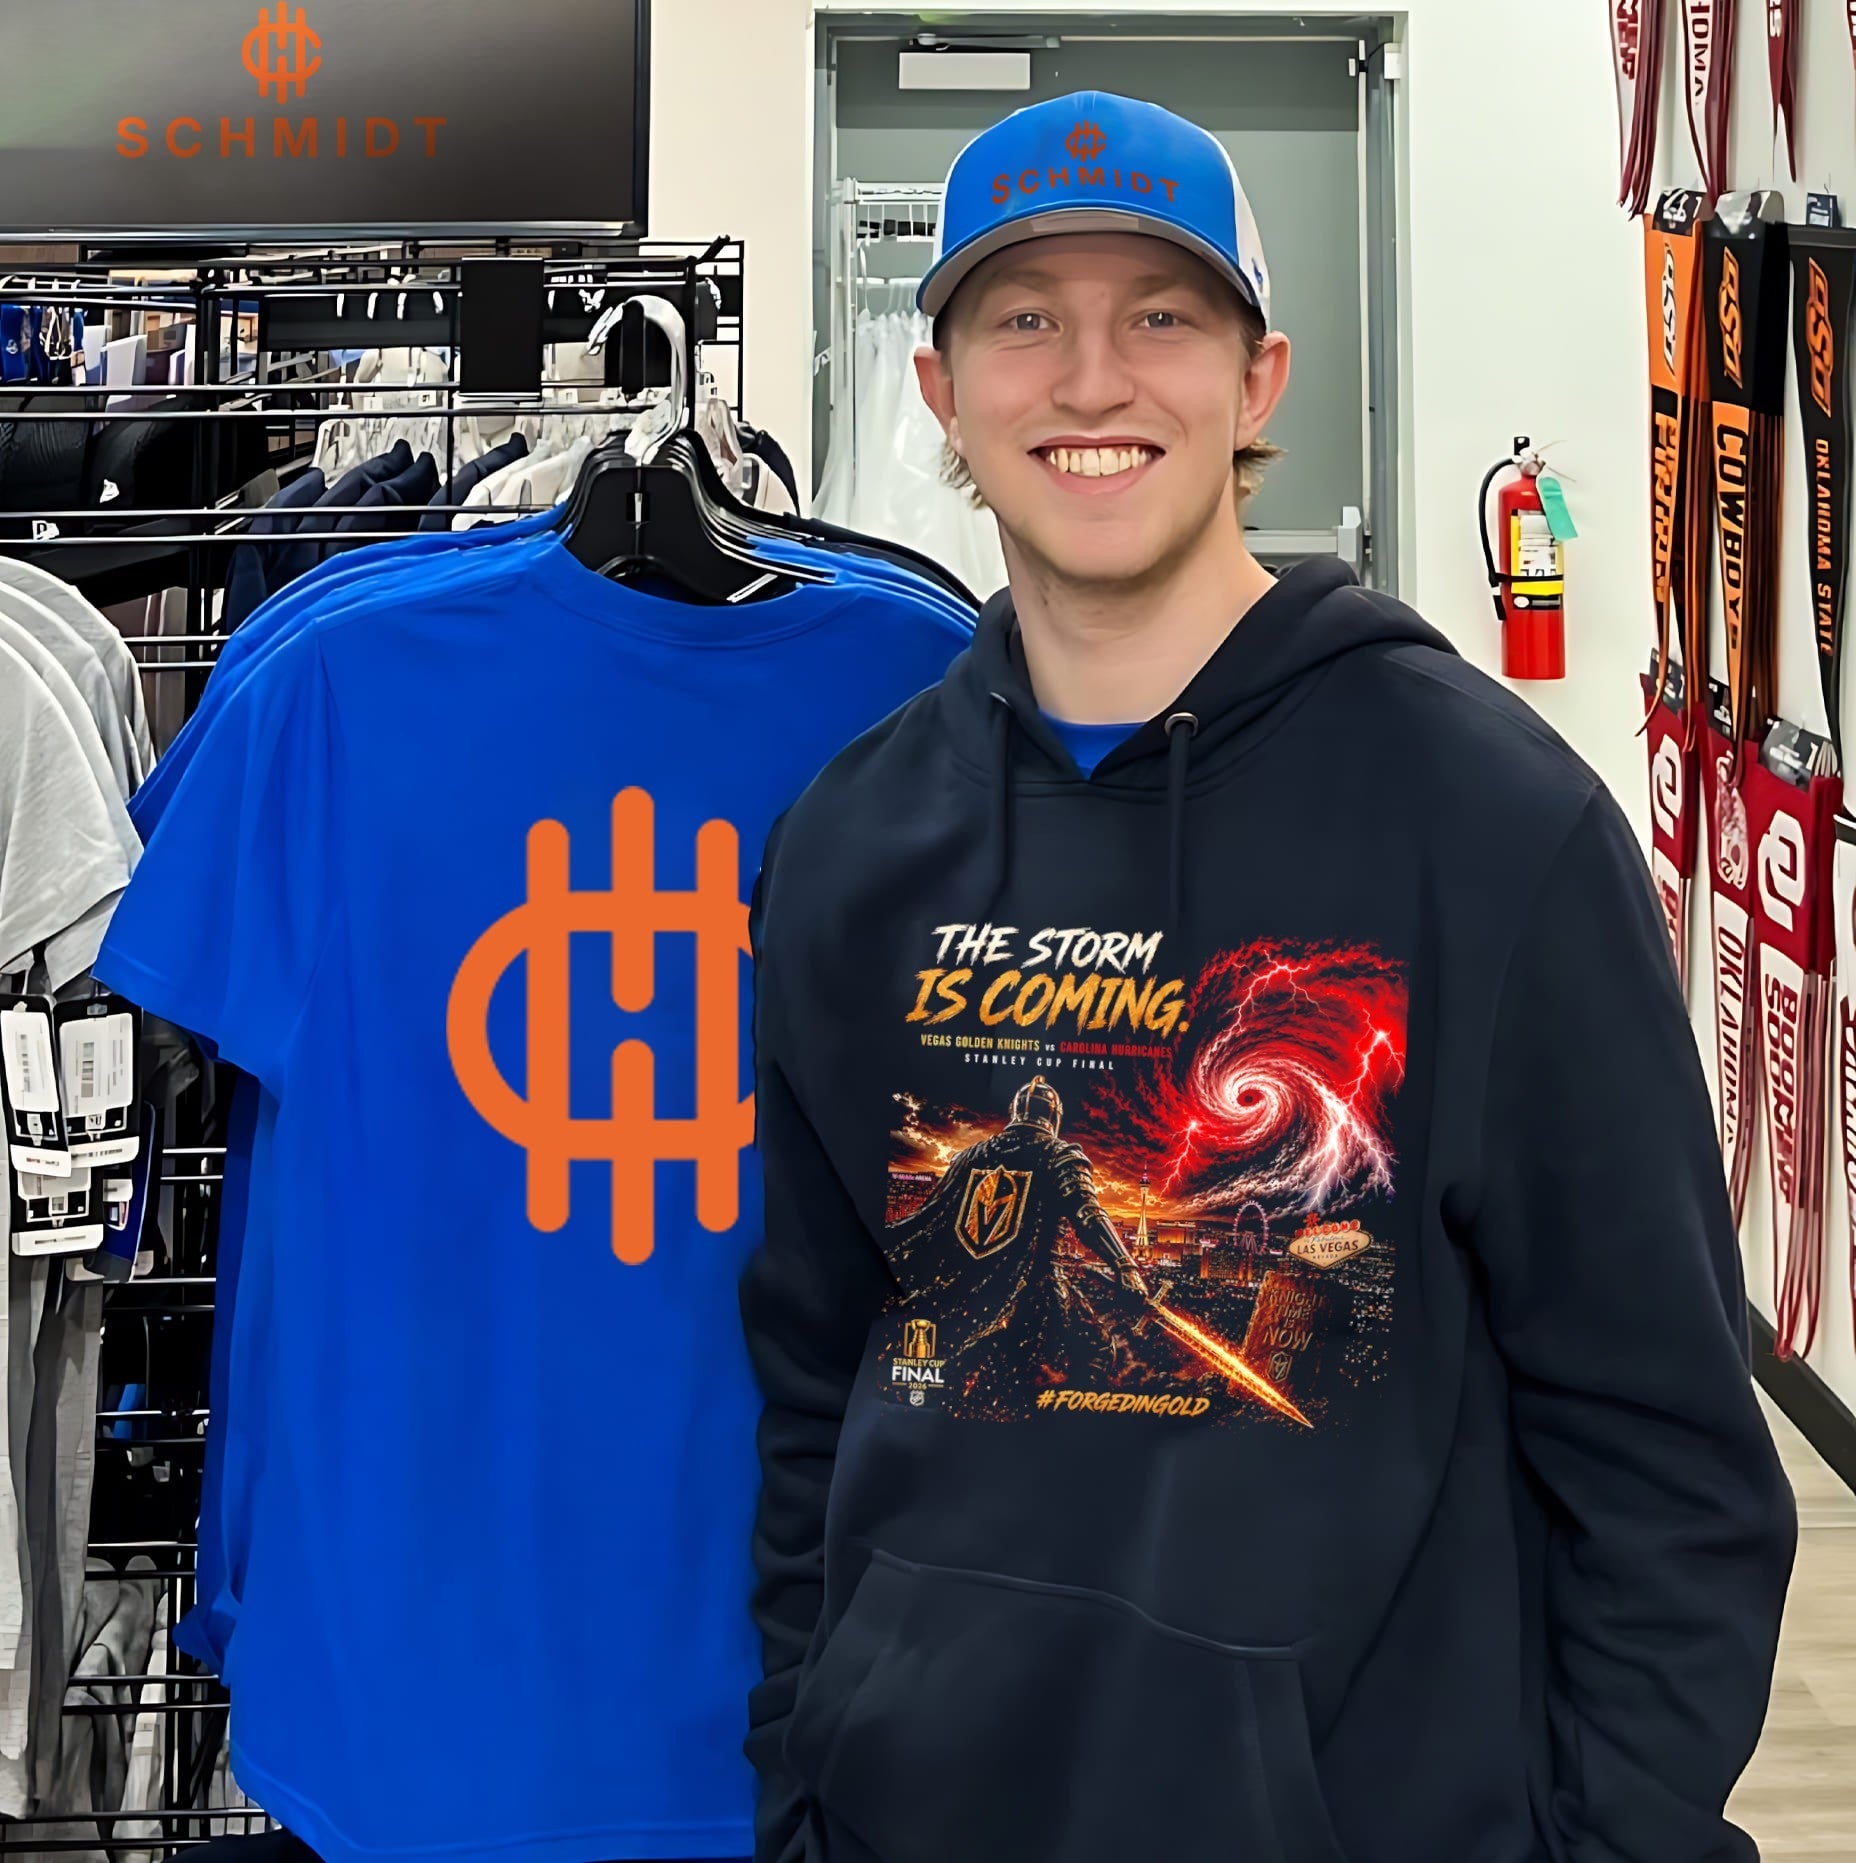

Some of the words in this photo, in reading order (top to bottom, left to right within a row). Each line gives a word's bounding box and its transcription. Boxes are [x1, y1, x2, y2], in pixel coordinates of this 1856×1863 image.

[115, 116, 448, 159] SCHMIDT
[991, 167, 1179, 205] SCHMIDT
[1815, 438, 1832, 571] OKLAHOMA
[931, 921, 1019, 966] THE
[1020, 927, 1164, 975] STORM
[905, 967, 973, 1026] IS
[979, 969, 1190, 1040] COMING.
[921, 1034, 951, 1047] VEGAS
[955, 1036, 993, 1049] GOLDEN
[997, 1037, 1040, 1051] KNIGHTS
[1059, 1041, 1108, 1055] CAROLINA
[1111, 1044, 1173, 1057] HURRICANES
[1718, 926, 1744, 1143] OKLAHOMA
[964, 1053, 1027, 1066] STANLEY
[1036, 1057, 1062, 1067] CUP
[1072, 1059, 1114, 1070] FINAL
[1295, 1219, 1361, 1237] WELCOME
[1297, 1243, 1316, 1254] LAS
[1319, 1240, 1359, 1253] VEGAS
[1263, 1326, 1313, 1351] NOW
[891, 1365, 945, 1383] FINAL
[892, 1357, 927, 1367] STANLEY
[928, 1359, 945, 1367] CUP
[908, 1382, 928, 1390] 2026
[1036, 1389, 1211, 1417] #FORGEDINGOLD
